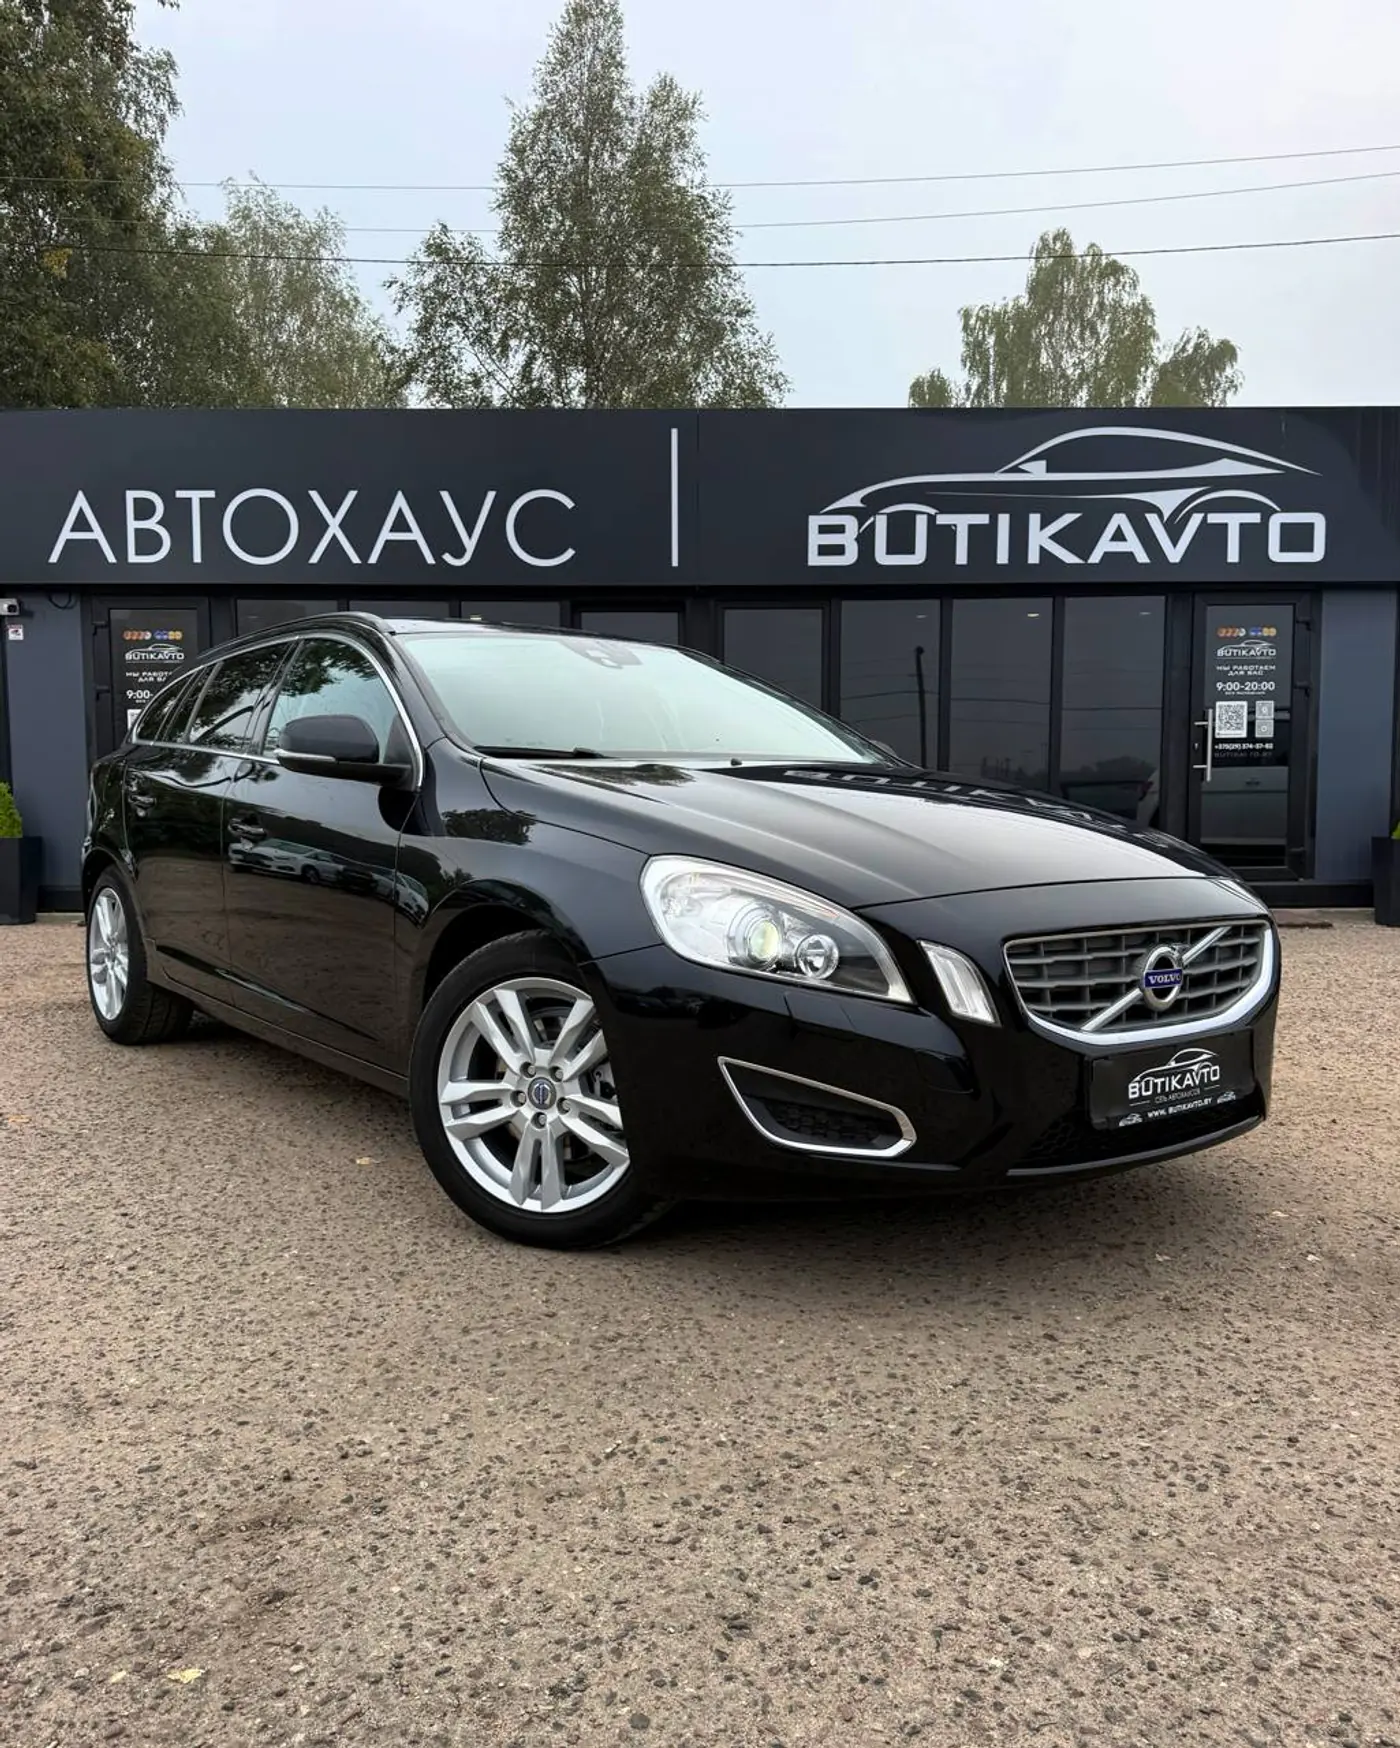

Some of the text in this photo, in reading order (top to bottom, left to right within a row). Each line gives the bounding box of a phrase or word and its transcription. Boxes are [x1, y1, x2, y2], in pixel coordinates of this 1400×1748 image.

[48, 488, 577, 567] АВТОХАУС
[807, 510, 1326, 567] BUTIKAVTO
[125, 651, 185, 661] BUTIKAVTO
[1216, 648, 1277, 657] BUTIKAVTO
[1216, 681, 1276, 691] 9:00-20:00
[1148, 972, 1181, 984] VOLVO
[1128, 1064, 1220, 1100] BUTIKAVTO
